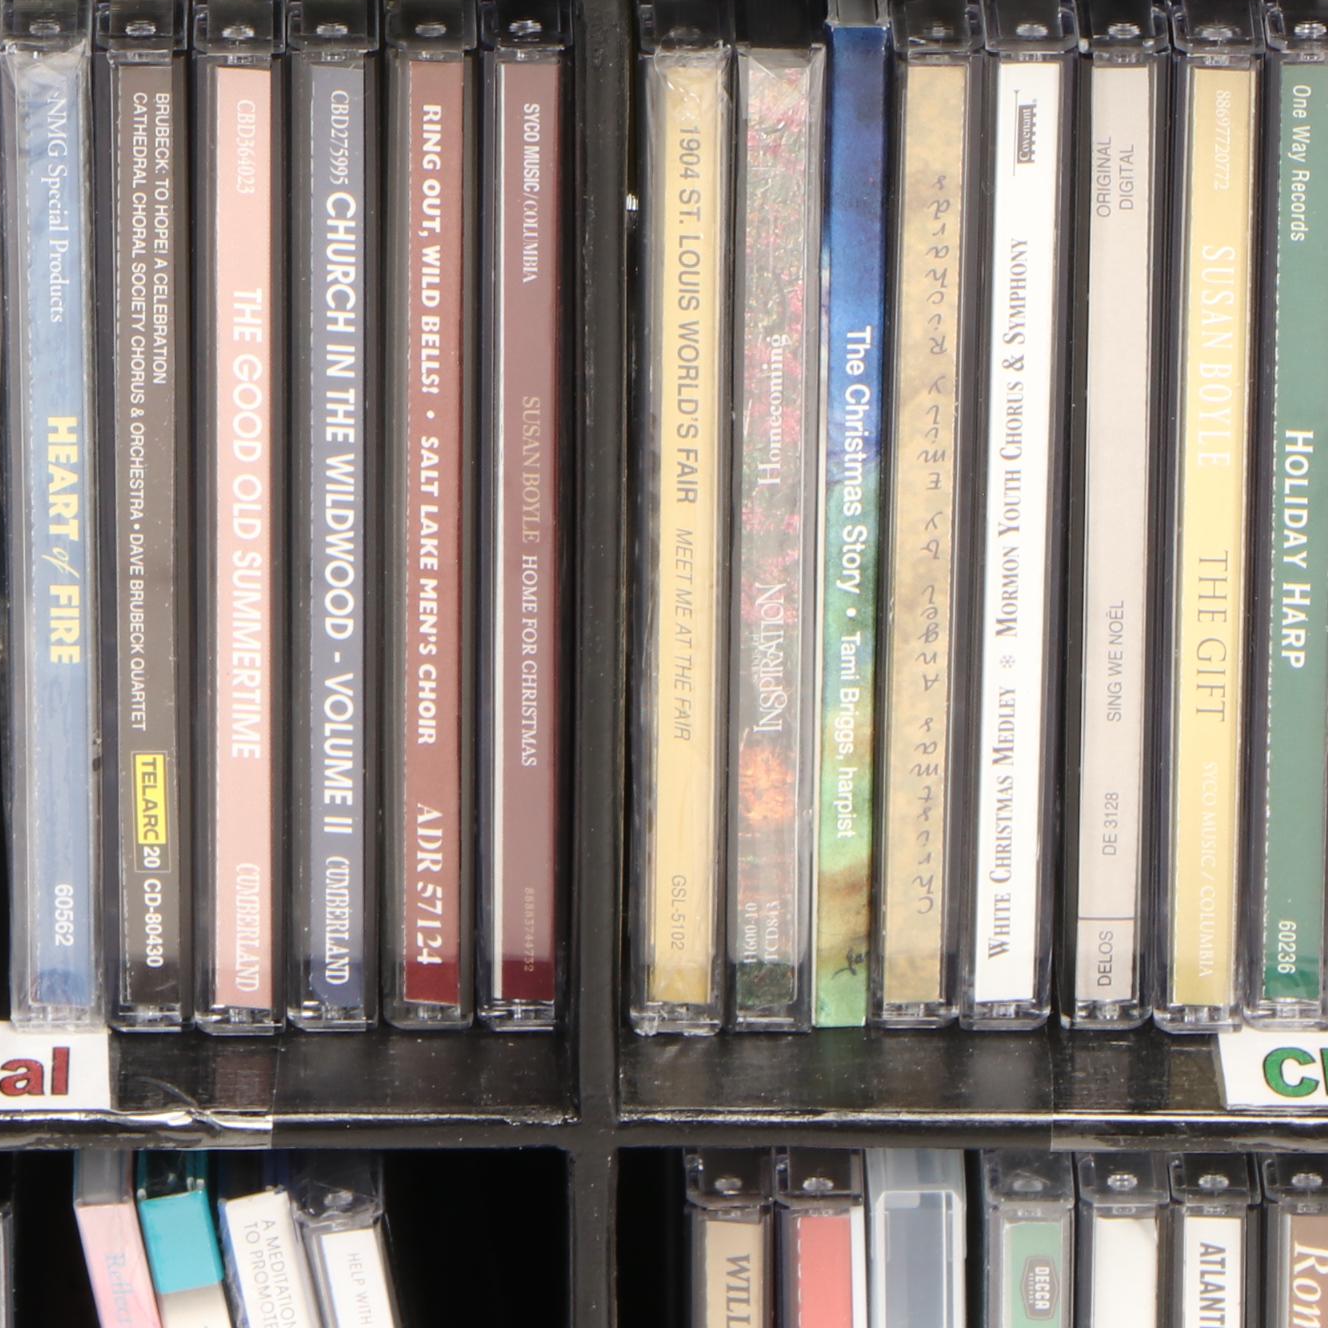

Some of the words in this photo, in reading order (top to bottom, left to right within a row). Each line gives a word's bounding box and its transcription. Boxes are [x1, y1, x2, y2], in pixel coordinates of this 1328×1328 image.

[422, 105, 441, 170] RING
[678, 125, 702, 180] 1904
[154, 178, 169, 200] TO
[418, 179, 441, 237] OUT,
[678, 188, 700, 225] ST.
[153, 205, 169, 254] HOPE!
[153, 257, 168, 269] A
[325, 191, 356, 332] CHURCH
[421, 245, 441, 307] WILD
[678, 235, 701, 310] LOUIS
[152, 273, 168, 384] CELEBRATION
[326, 345, 355, 375] IN
[421, 316, 440, 393] BELLS!
[846, 326, 872, 373] The
[677, 320, 700, 440] WORLD'S
[326, 387, 355, 442] THE
[47, 416, 78, 538] HEART
[420, 436, 438, 495] SALT
[676, 448, 698, 503] FAIR
[843, 384, 869, 515] Christmas
[1284, 429, 1314, 569] HOLIDAY
[43, 548, 80, 576] of
[324, 453, 355, 639] WILDWOOD
[420, 504, 438, 570] LAKE
[838, 524, 867, 593] Story
[49, 585, 81, 663] FIRE
[419, 578, 437, 655] MEN'S
[1282, 582, 1311, 669] HARP
[418, 663, 437, 743] CHOIR
[324, 674, 353, 805] VOLUME
[140, 757, 160, 841] TELARC
[325, 816, 352, 833] II
[416, 804, 441, 872] ADR
[55, 884, 74, 945] 60562
[144, 879, 163, 967] CD-80430
[416, 881, 443, 964] 57124
[1278, 920, 1297, 972] 60236
[1034, 1266, 1051, 1309] DECCA
